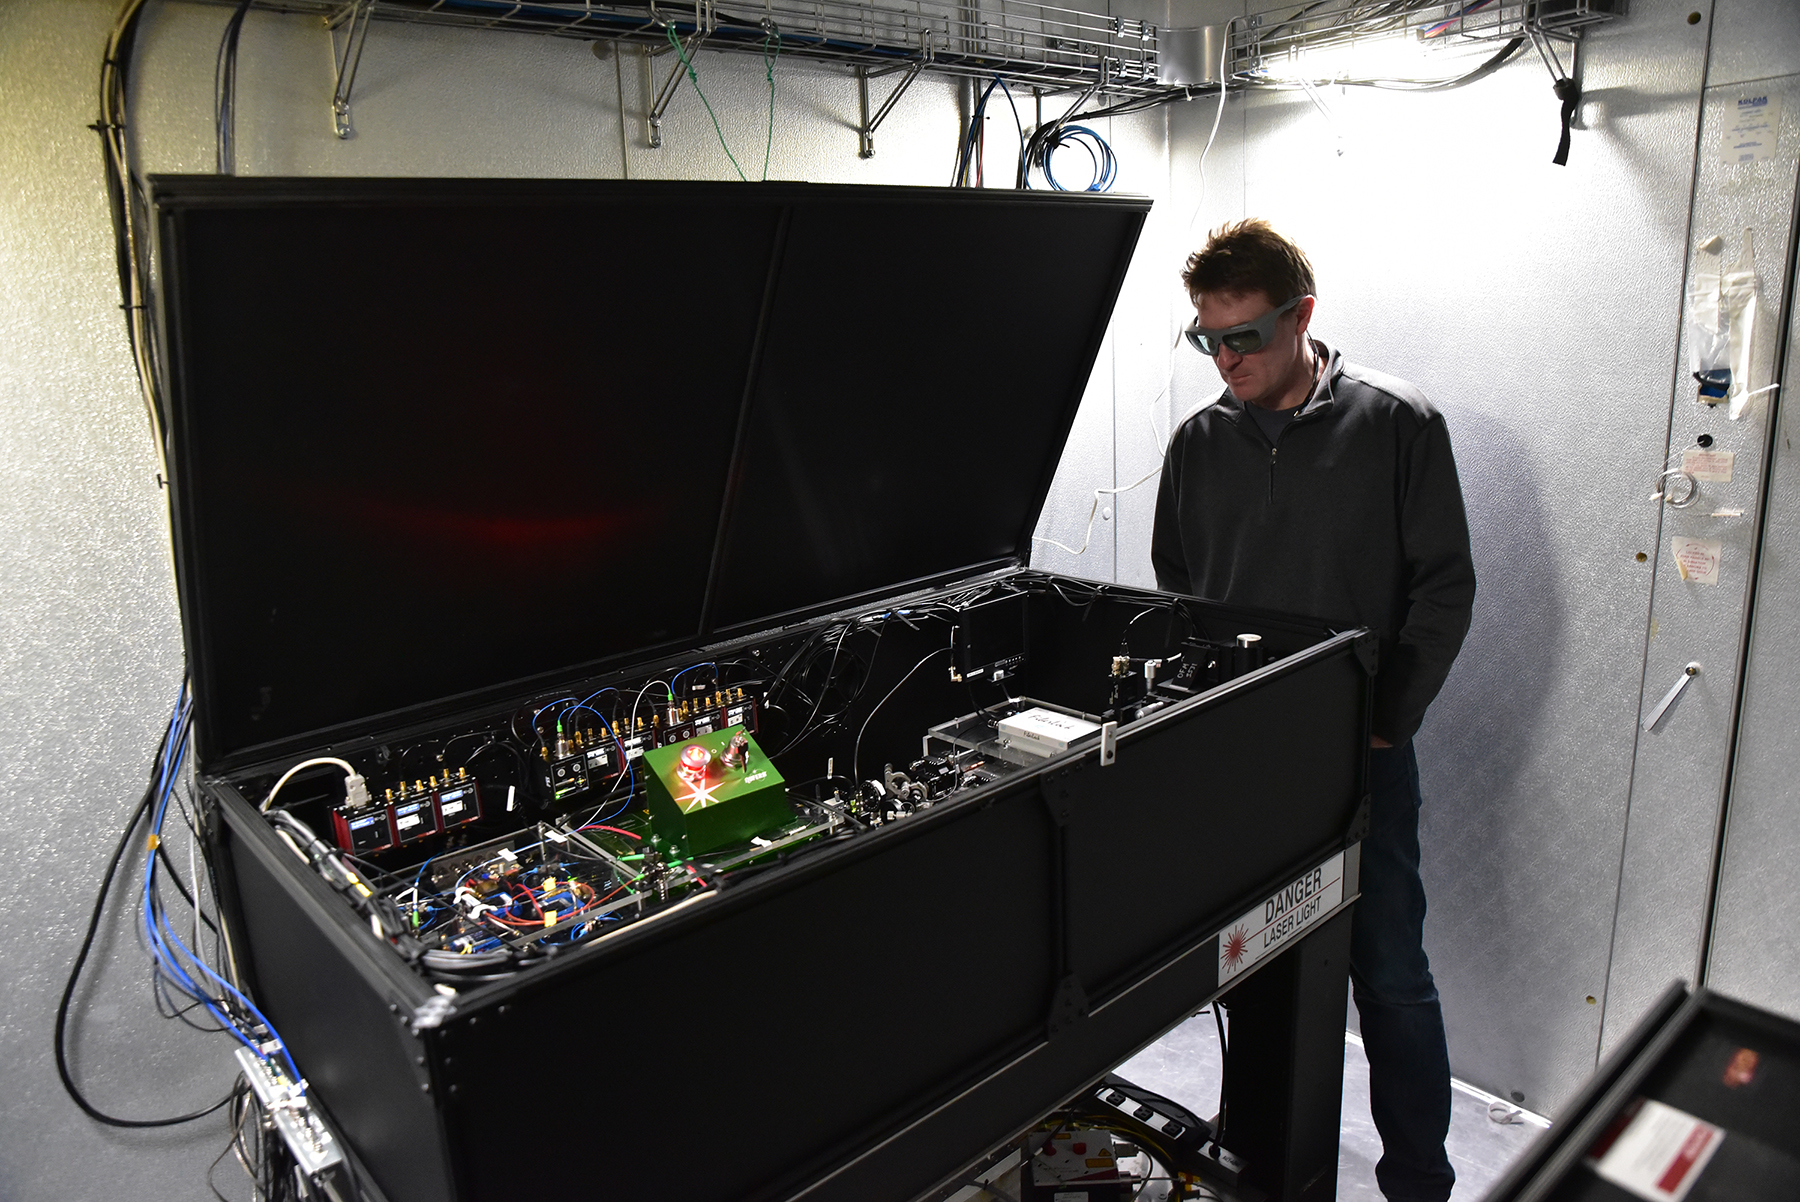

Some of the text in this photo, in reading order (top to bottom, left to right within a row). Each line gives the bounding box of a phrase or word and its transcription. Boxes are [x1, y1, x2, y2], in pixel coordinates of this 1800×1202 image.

[1263, 895, 1322, 949] LASER LIGHT
[1265, 867, 1322, 925] DANGER
